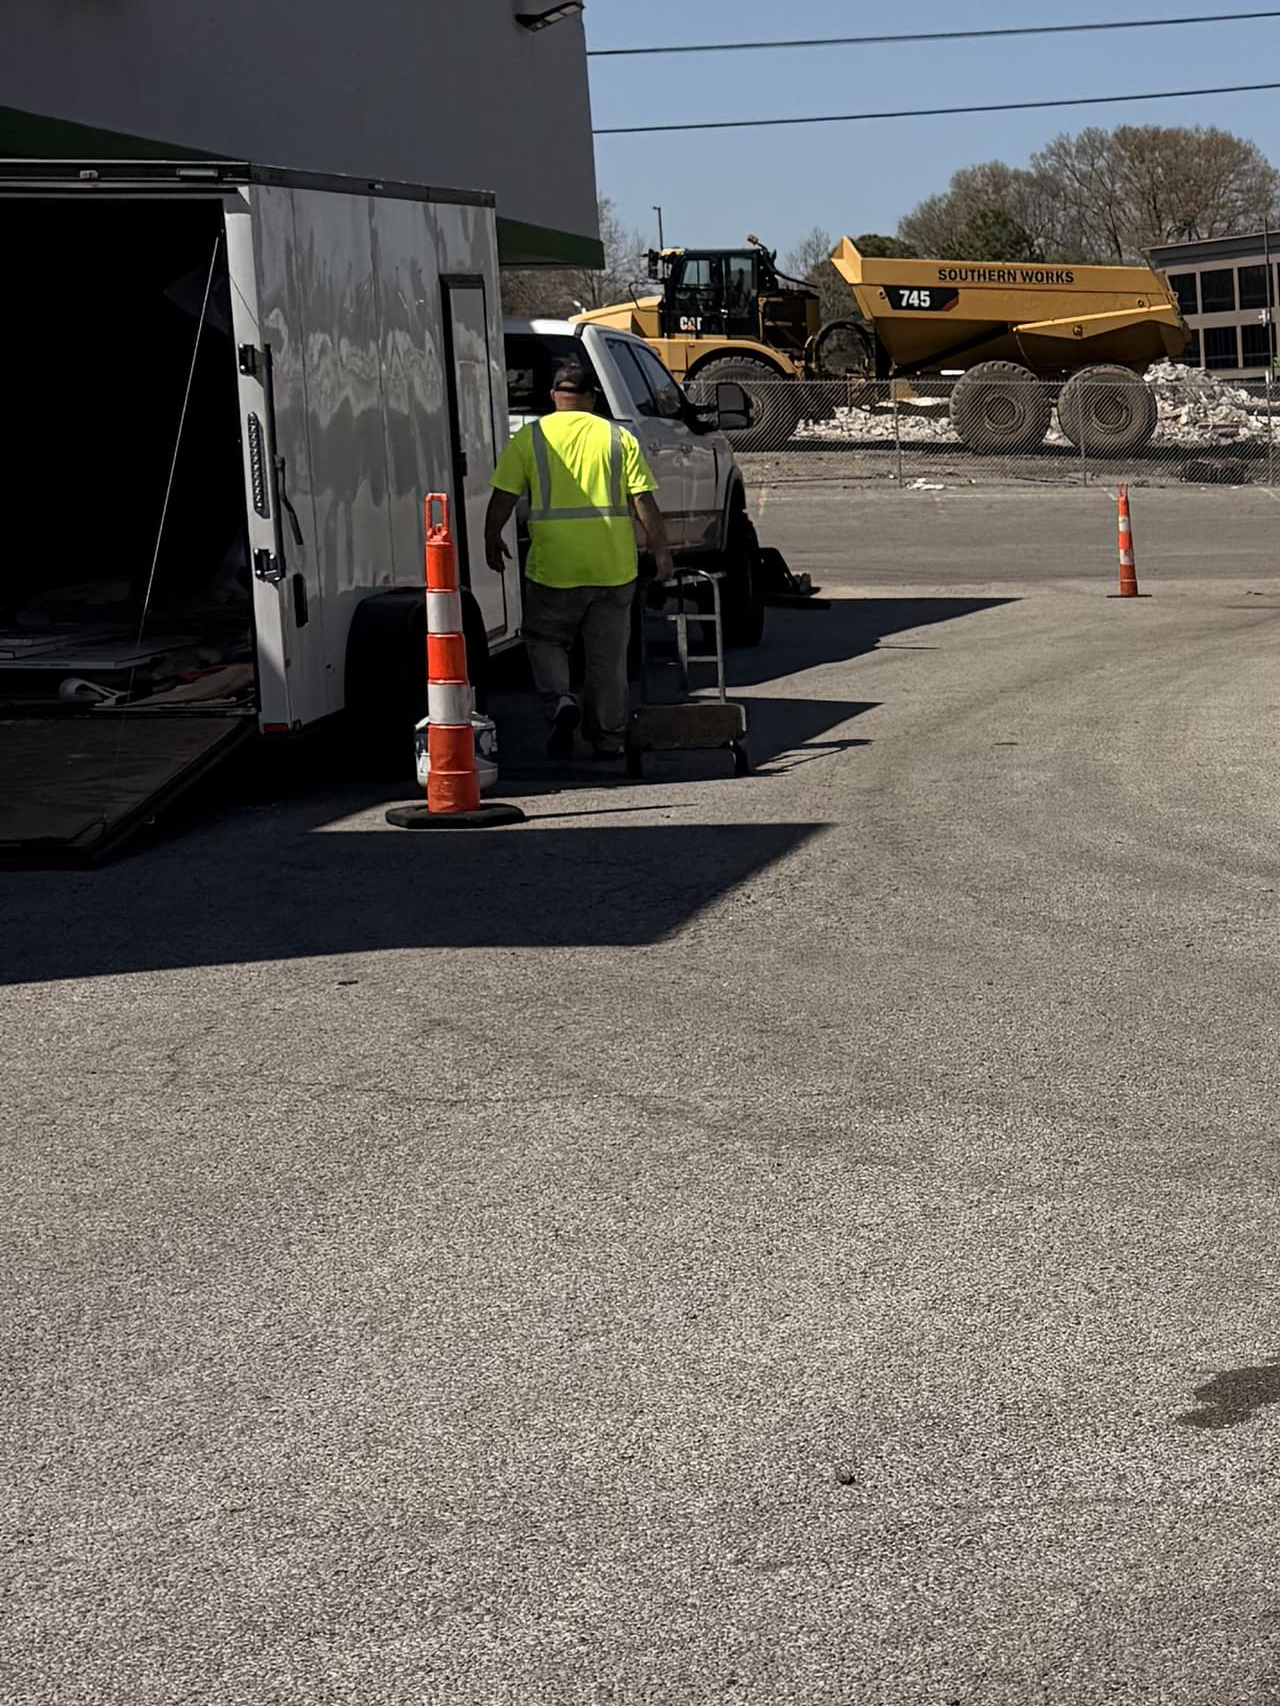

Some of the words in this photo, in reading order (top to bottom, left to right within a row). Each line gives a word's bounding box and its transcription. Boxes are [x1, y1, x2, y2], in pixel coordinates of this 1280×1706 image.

[938, 268, 1017, 283] SOUTHERN
[1020, 270, 1075, 284] WORKS
[899, 290, 931, 307] 745
[680, 316, 705, 332] CAT
